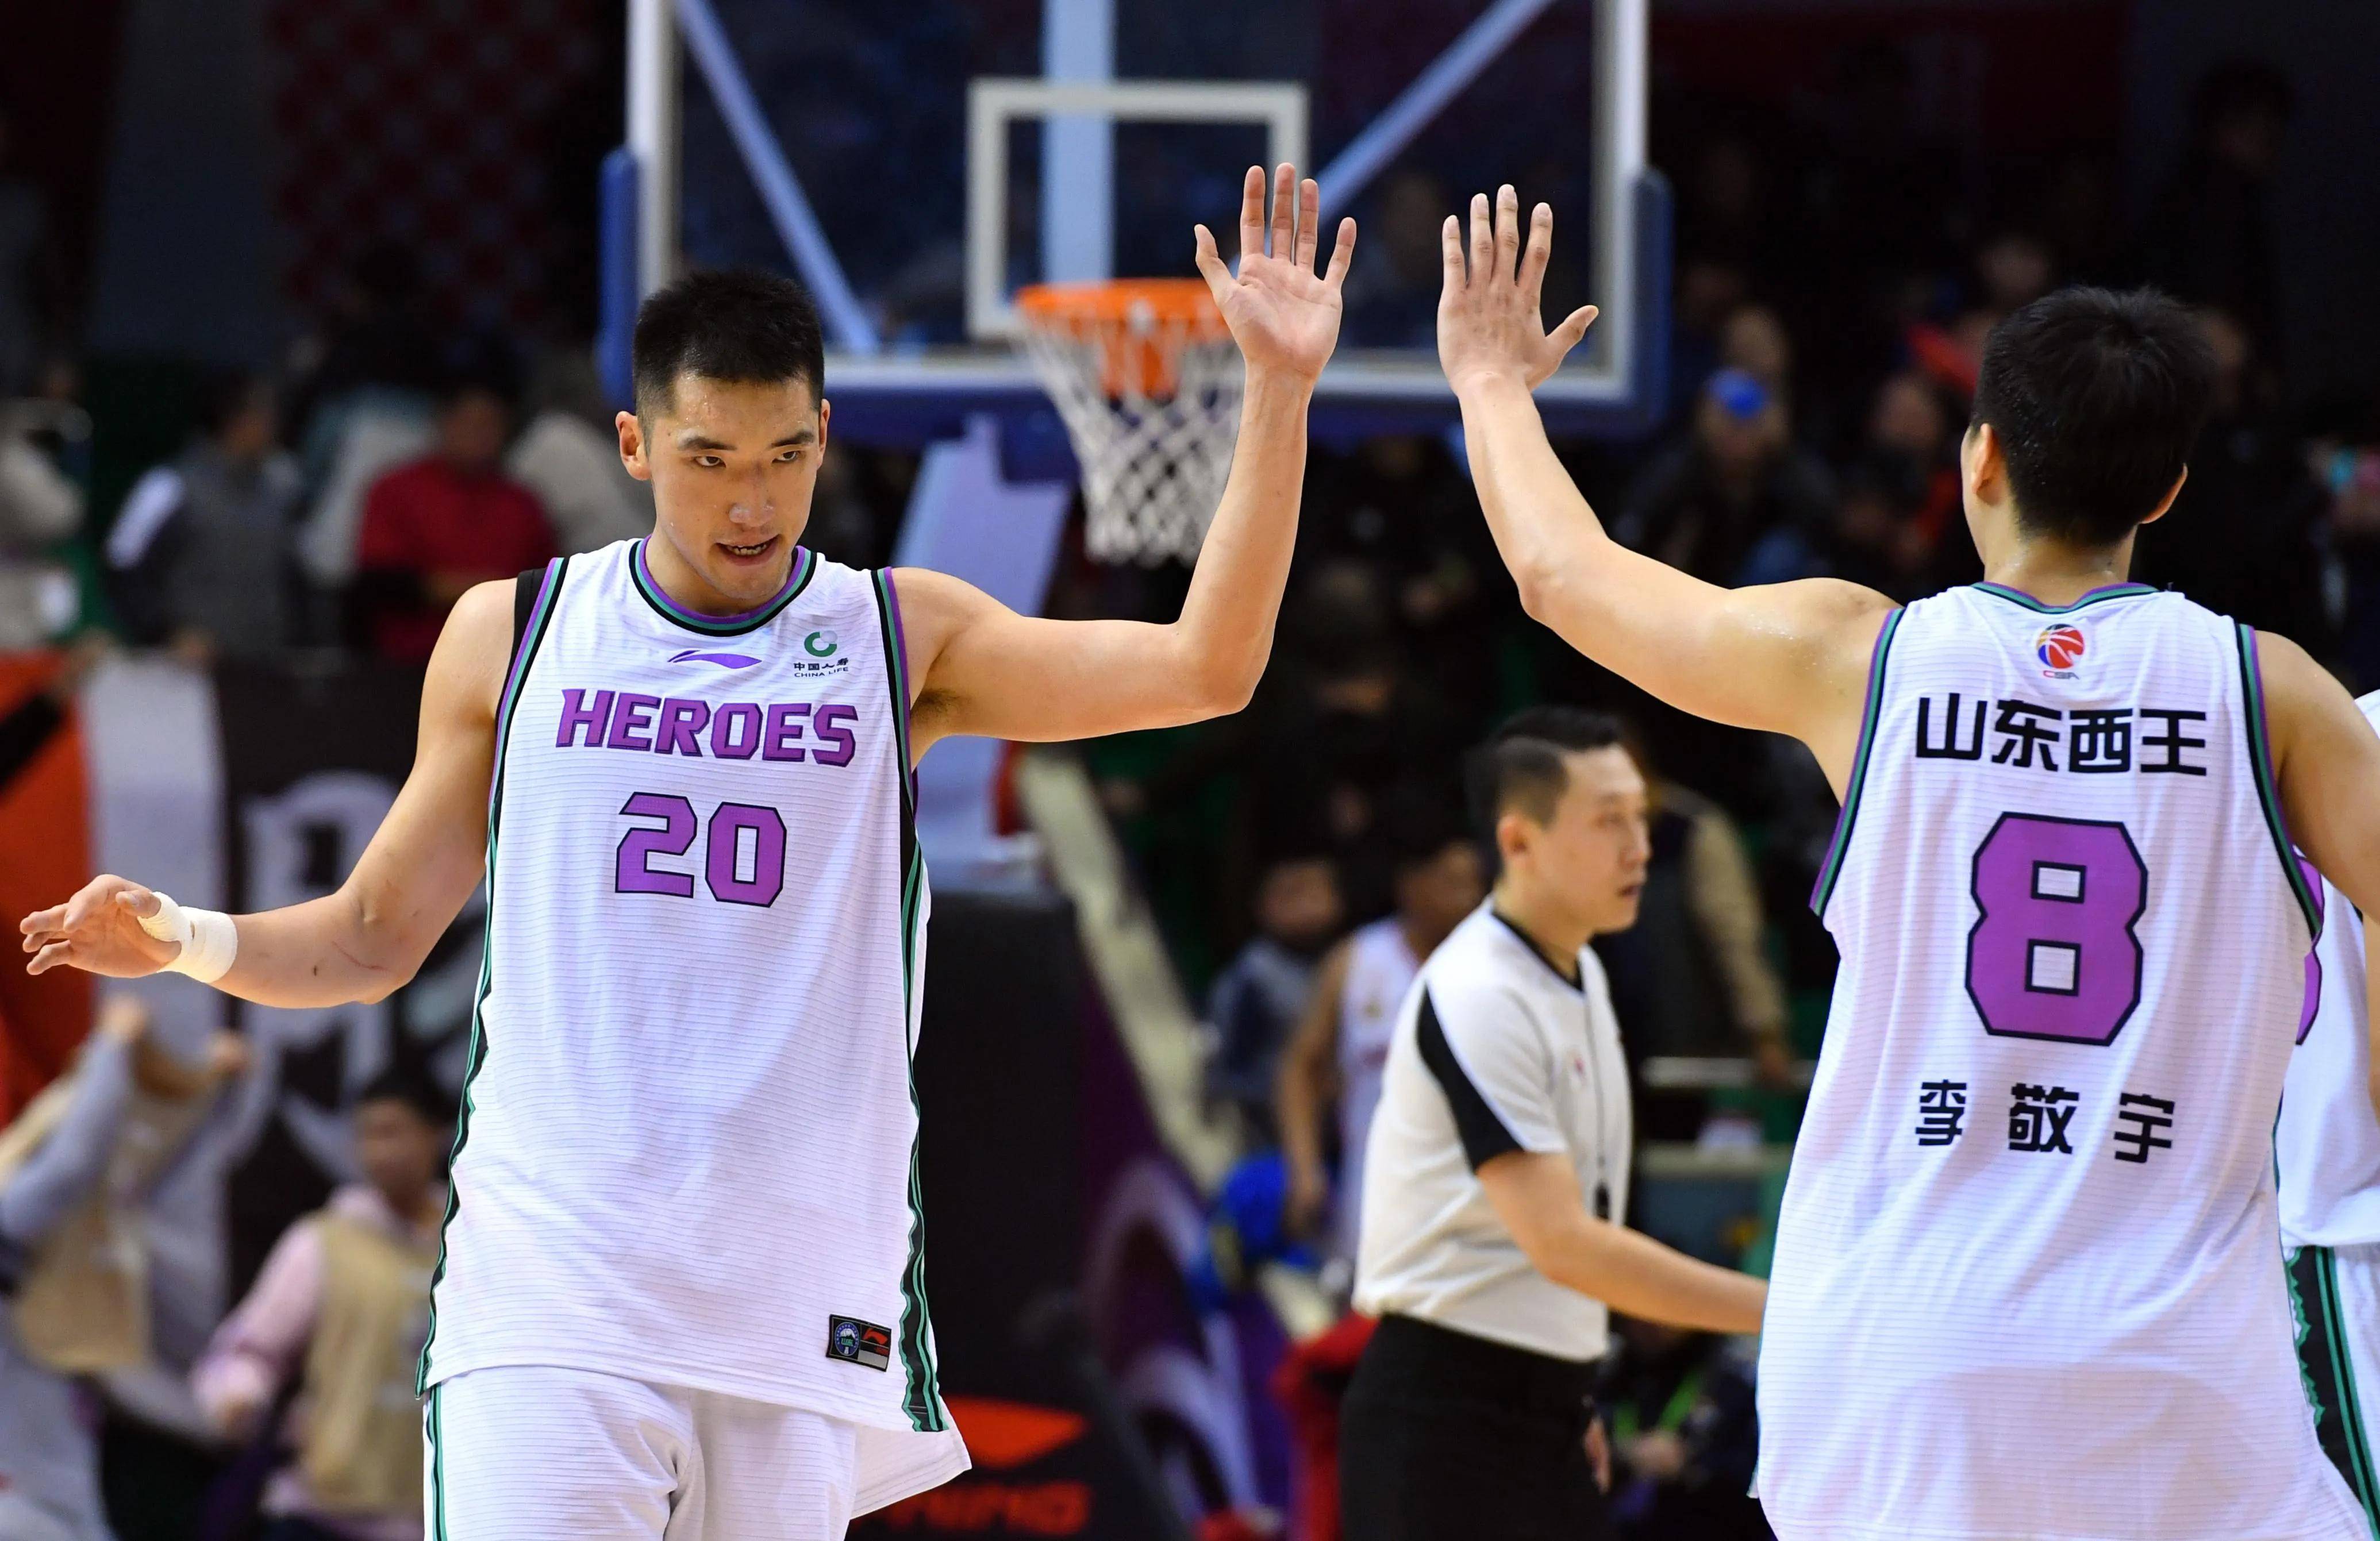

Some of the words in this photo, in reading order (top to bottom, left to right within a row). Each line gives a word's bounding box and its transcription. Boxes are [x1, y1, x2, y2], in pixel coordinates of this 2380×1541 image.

[793, 657, 849, 671] 中国人寿
[828, 667, 848, 675] LIFE
[556, 688, 859, 768] HEROES
[1915, 692, 2207, 776] 山东西王
[615, 791, 787, 908] 20
[1964, 811, 2148, 1046] 8
[1914, 1078, 2175, 1164] 李敬宇
